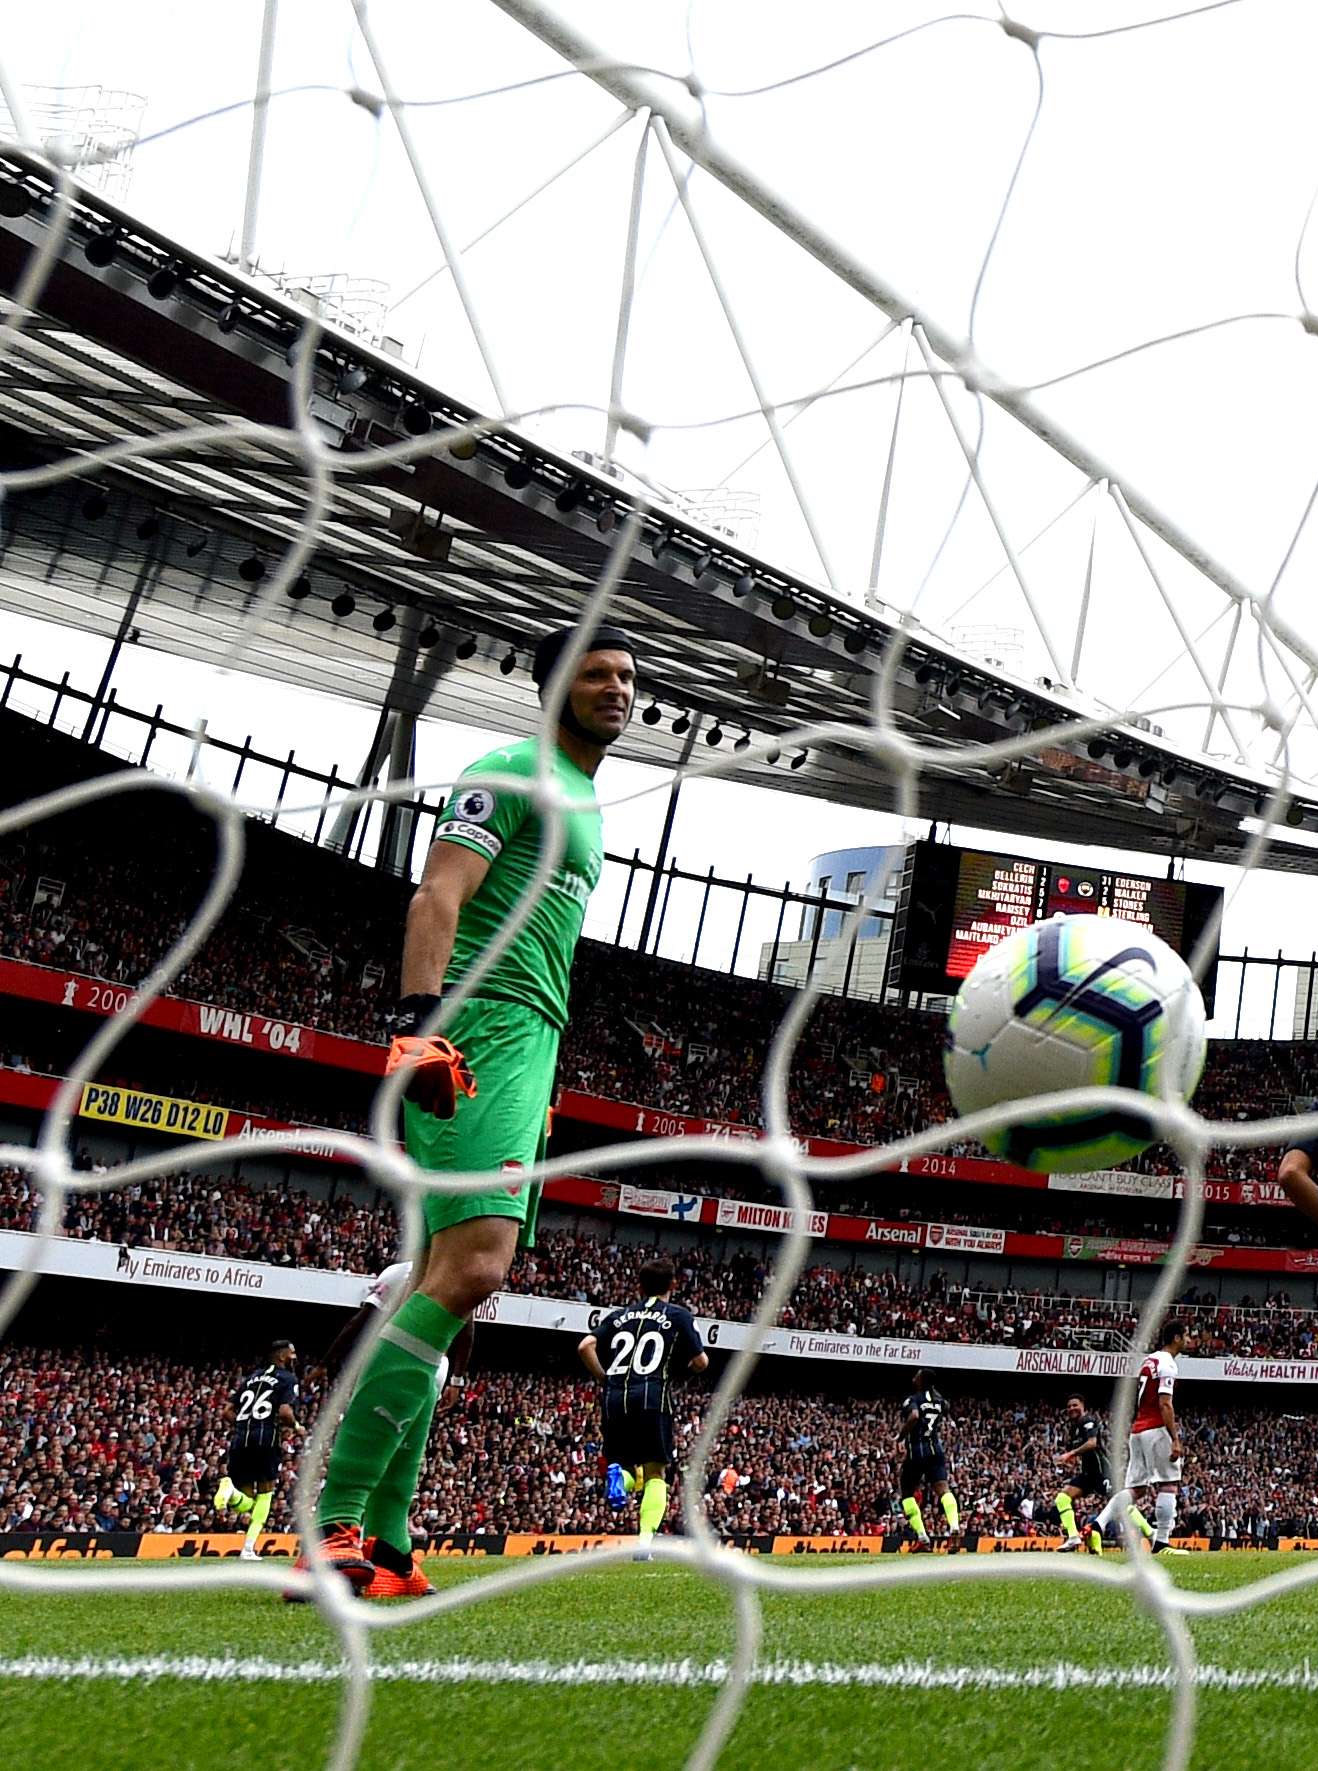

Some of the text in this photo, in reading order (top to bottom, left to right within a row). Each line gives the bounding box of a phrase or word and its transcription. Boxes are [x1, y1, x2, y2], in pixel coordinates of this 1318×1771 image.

[457, 824, 499, 851] Captai
[200, 1006, 252, 1043] WHL
[85, 1088, 120, 1117] P38
[125, 1095, 162, 1125] W26
[167, 1103, 198, 1130] D12
[651, 1116, 685, 1137] 2005
[921, 1157, 956, 1175] 2014
[1117, 1174, 1138, 1185] BUY
[737, 1205, 781, 1229] MILTON
[866, 1223, 921, 1243] Arsenal
[143, 1258, 201, 1281] Emirates
[204, 1266, 219, 1284] to
[222, 1266, 263, 1289] Africa
[614, 1311, 672, 1331] BERNARDO
[606, 1330, 665, 1375] 20
[790, 1336, 920, 1360] Fly Emirates to the Far East
[1223, 1359, 1258, 1381] Vitality
[1260, 1366, 1306, 1379] HEALTH
[236, 1389, 274, 1421] 26
[924, 1413, 938, 1437] 7
